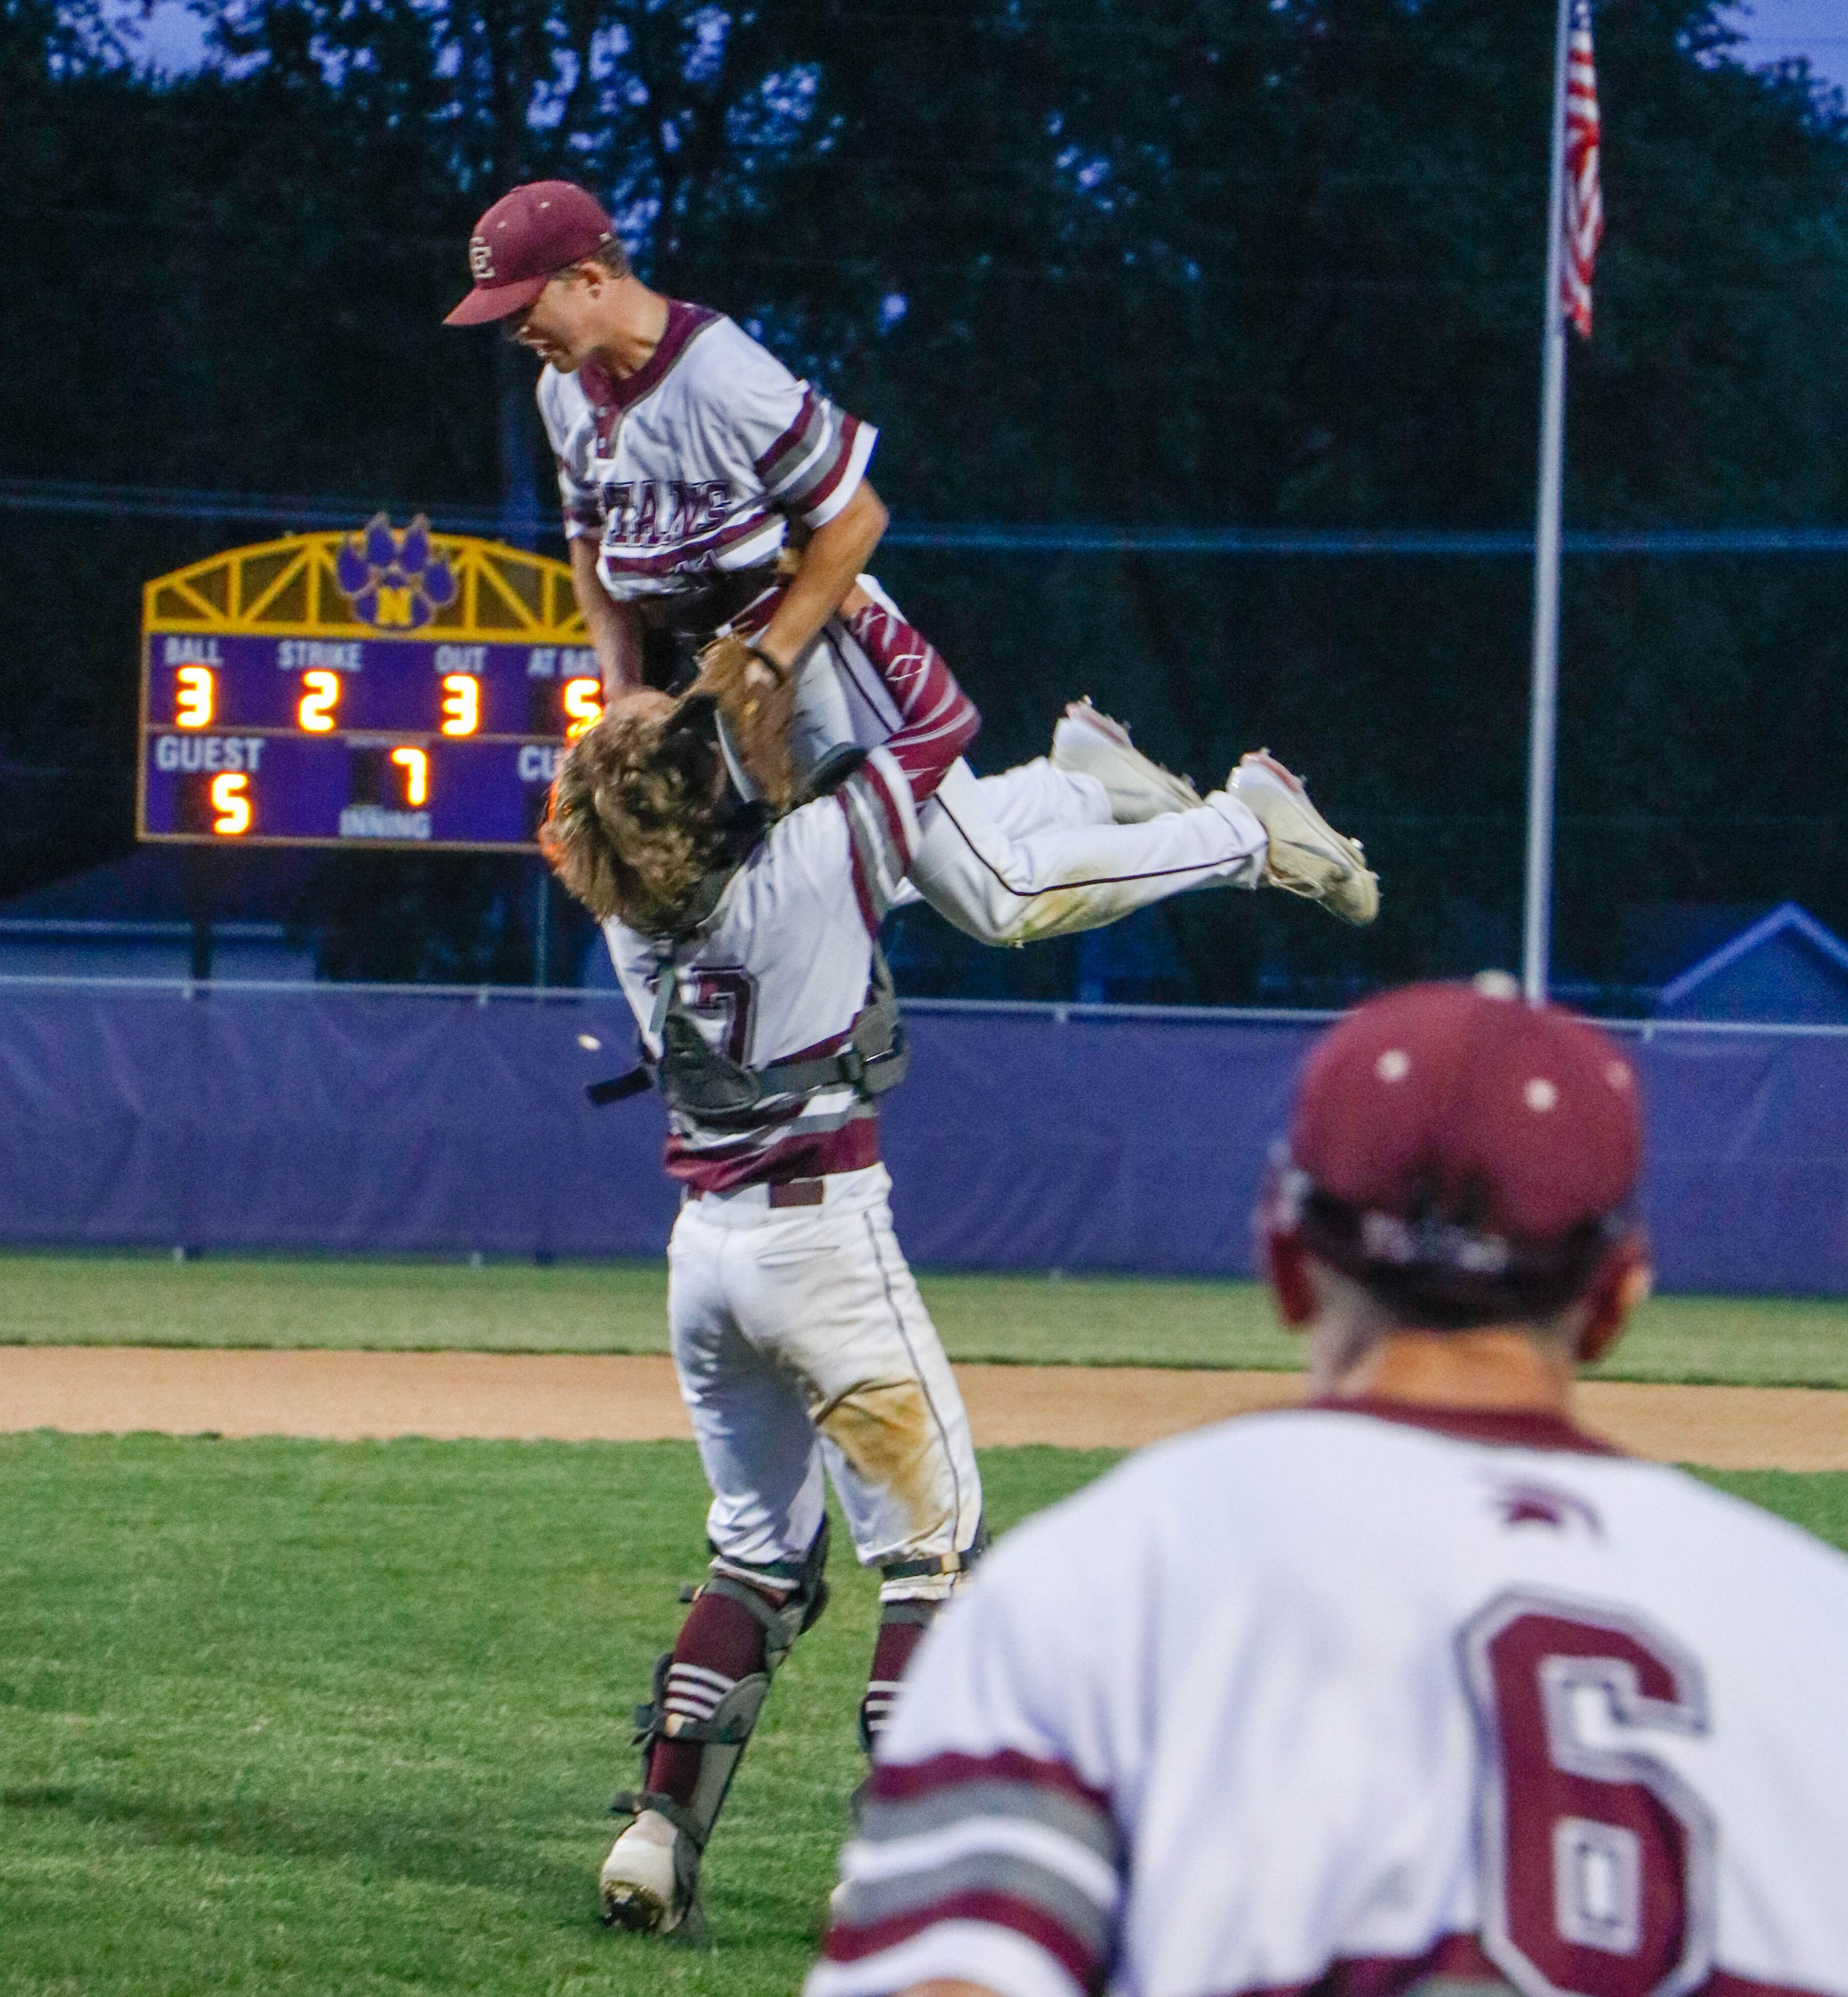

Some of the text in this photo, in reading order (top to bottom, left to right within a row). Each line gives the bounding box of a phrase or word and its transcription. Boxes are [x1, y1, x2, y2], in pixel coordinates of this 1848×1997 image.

[376, 586, 412, 625] M
[165, 638, 222, 665] BALL
[278, 640, 362, 671] STRIKE
[435, 645, 487, 673] OUT
[529, 647, 556, 676] AT
[177, 666, 213, 727] 3
[299, 671, 339, 732] 2
[442, 675, 479, 736] 3
[564, 678, 602, 737] 5
[156, 735, 266, 771] GUEST
[519, 745, 556, 780] CU
[391, 748, 428, 806] 7
[212, 773, 251, 835] 5
[339, 809, 431, 840] INNING
[1454, 1579, 1717, 1997] 6
